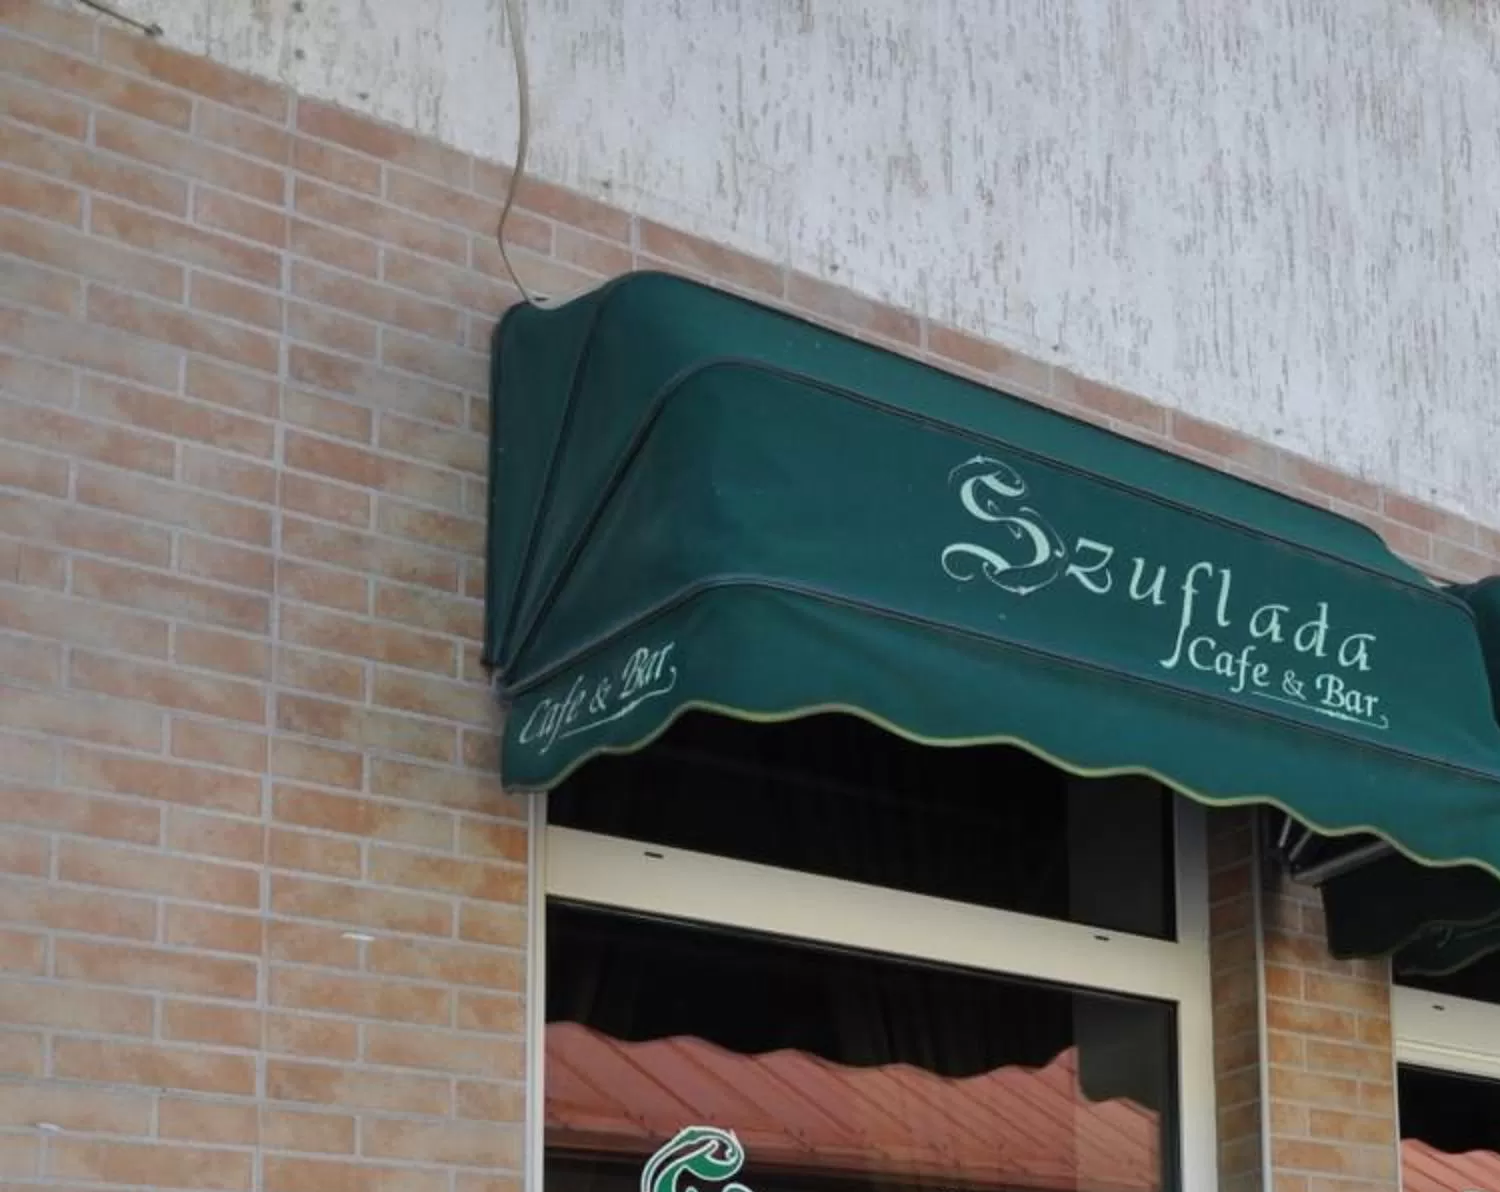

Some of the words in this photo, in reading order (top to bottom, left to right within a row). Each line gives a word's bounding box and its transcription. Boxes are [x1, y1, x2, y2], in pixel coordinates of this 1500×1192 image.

[940, 454, 1377, 668] Szuflada
[519, 673, 586, 753] Cafe
[588, 675, 613, 713] &
[619, 641, 675, 704] Bar
[1187, 637, 1270, 692] Cafe
[1281, 669, 1306, 697] &
[1315, 674, 1380, 720] Bar
